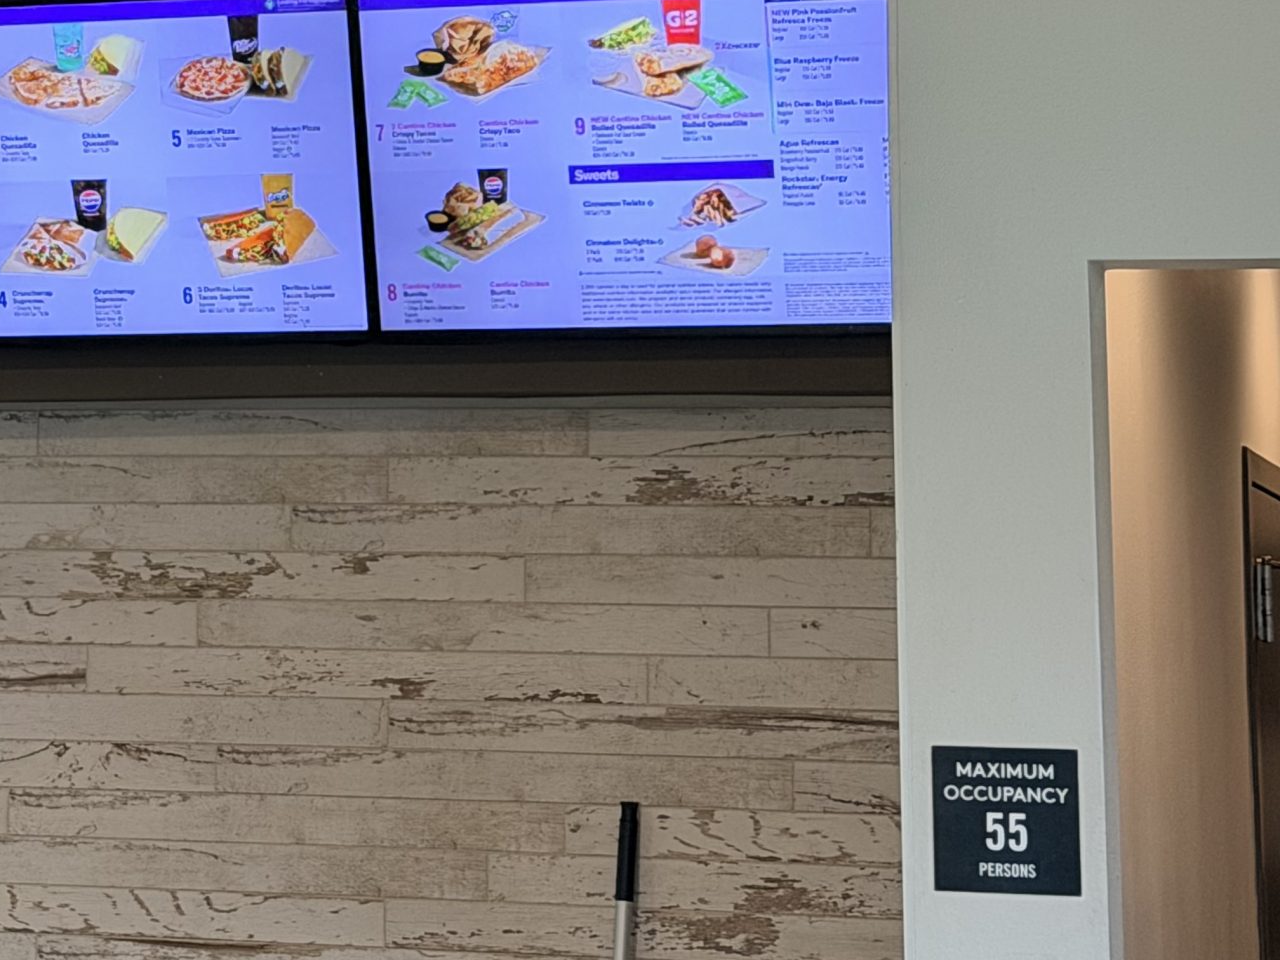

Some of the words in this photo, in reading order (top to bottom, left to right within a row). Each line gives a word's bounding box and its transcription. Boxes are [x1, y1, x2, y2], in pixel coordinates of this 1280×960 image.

[793, 56, 832, 65] Raspberry
[376, 124, 384, 142] 7
[574, 117, 586, 136] 9
[172, 130, 182, 148] 5
[574, 168, 620, 182] Sweets
[182, 287, 194, 304] 6
[388, 283, 397, 301] 8
[955, 761, 1055, 780] MAXIMUM
[943, 784, 1069, 804] OCCUPANCY
[985, 811, 1028, 852] 55
[978, 862, 1037, 878] PERSONS
